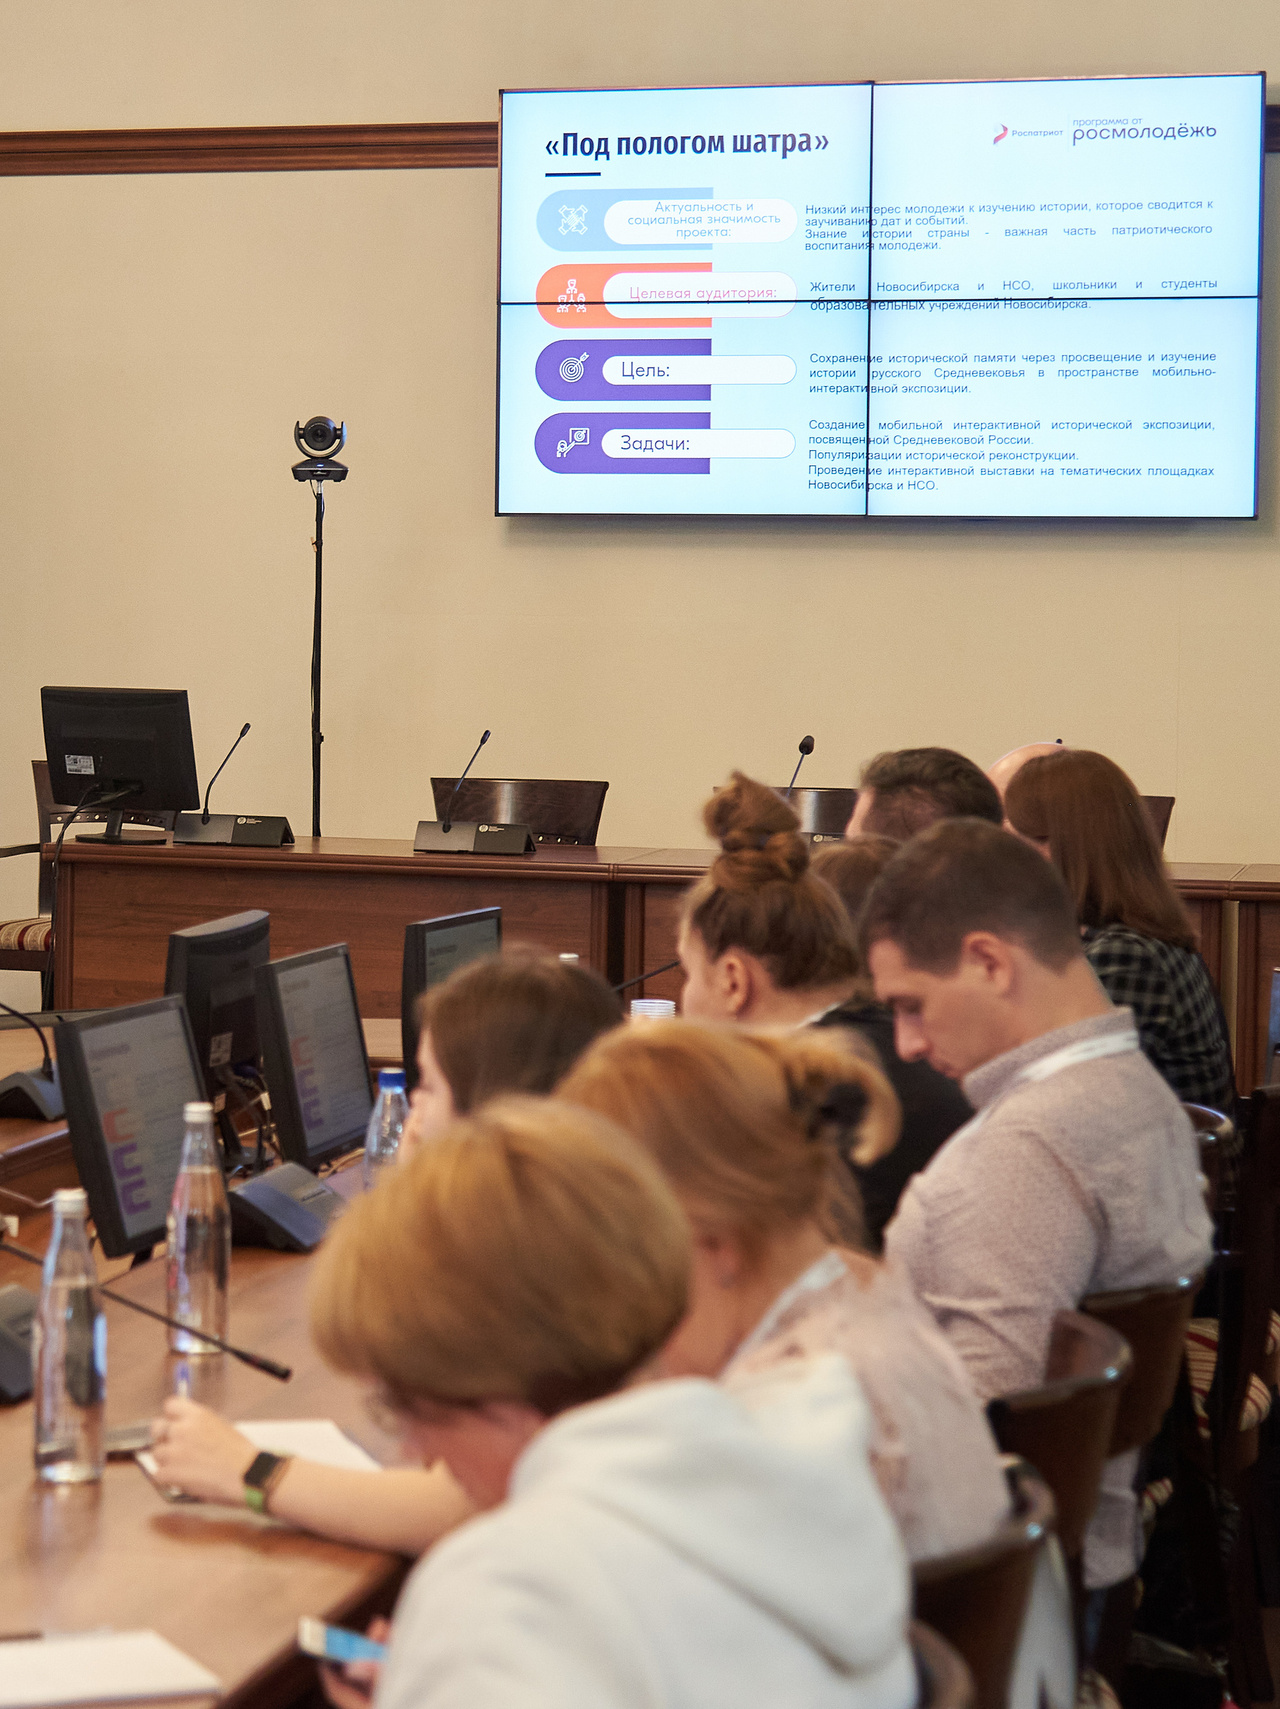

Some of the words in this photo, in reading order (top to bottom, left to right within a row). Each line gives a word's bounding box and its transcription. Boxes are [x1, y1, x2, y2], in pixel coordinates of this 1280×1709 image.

[1073, 118, 1128, 127] программа
[1072, 123, 1217, 146] росмолодёжь
[545, 132, 610, 161] «Под
[617, 133, 725, 155] пологом
[732, 132, 829, 159] шатра»
[654, 201, 742, 213] Актуальность
[746, 203, 754, 211] и
[805, 204, 846, 215] Низкий
[905, 205, 965, 215] молодежи
[979, 203, 1036, 215] изучению
[1039, 202, 1092, 213] истории,
[1096, 202, 1144, 211] которое
[1147, 200, 1203, 211] сводится
[627, 215, 703, 226] социальная
[707, 213, 781, 224] значимость
[881, 218, 901, 227] дат
[915, 216, 969, 226] событий.
[676, 227, 732, 239] проекта:
[805, 229, 847, 239] Знание
[862, 230, 912, 240] истории
[927, 230, 970, 239] страны
[1004, 228, 1048, 237] важная
[1063, 227, 1097, 236] часть
[1111, 225, 1213, 237] патриотического
[878, 241, 942, 251] молодежи.
[810, 282, 856, 292] Жители
[876, 281, 960, 293] Новосибирска
[977, 283, 985, 291] и
[1002, 280, 1035, 292] НСО,
[1052, 280, 1117, 290] школьники
[1135, 281, 1143, 289] и
[1161, 279, 1218, 291] студенты
[629, 287, 691, 300] Целевая
[696, 287, 777, 301] аудитория:
[888, 353, 968, 364] исторической
[973, 354, 1016, 363] памяти
[1022, 354, 1056, 364] через
[1061, 353, 1142, 364] просвещение
[1148, 353, 1155, 362] и
[1161, 352, 1217, 363] изучение
[621, 361, 671, 380] Цель:
[809, 369, 857, 379] истории
[871, 369, 922, 380] русского
[934, 367, 1025, 379] Средневековья
[1038, 369, 1045, 377] в
[1057, 368, 1139, 379] пространстве
[1152, 366, 1217, 377] мобильно-
[901, 384, 972, 395] экспозиции.
[808, 420, 865, 432] Создание
[878, 420, 943, 431] мобильной
[953, 420, 1041, 431] интерактивной
[1051, 420, 1133, 431] исторической
[1143, 420, 1216, 431] экспозиции,
[620, 434, 690, 453] Задачи:
[893, 434, 985, 446] Средневековой
[988, 435, 1034, 445] России.
[905, 450, 986, 461] исторической
[989, 451, 1079, 462] реконструкции.
[888, 466, 975, 477] интерактивной
[980, 467, 1035, 476] выставки
[1040, 468, 1055, 476] на
[1060, 467, 1142, 476] тематических
[1147, 467, 1215, 477] площадках
[897, 482, 904, 491] и
[907, 481, 939, 491] НСО.
